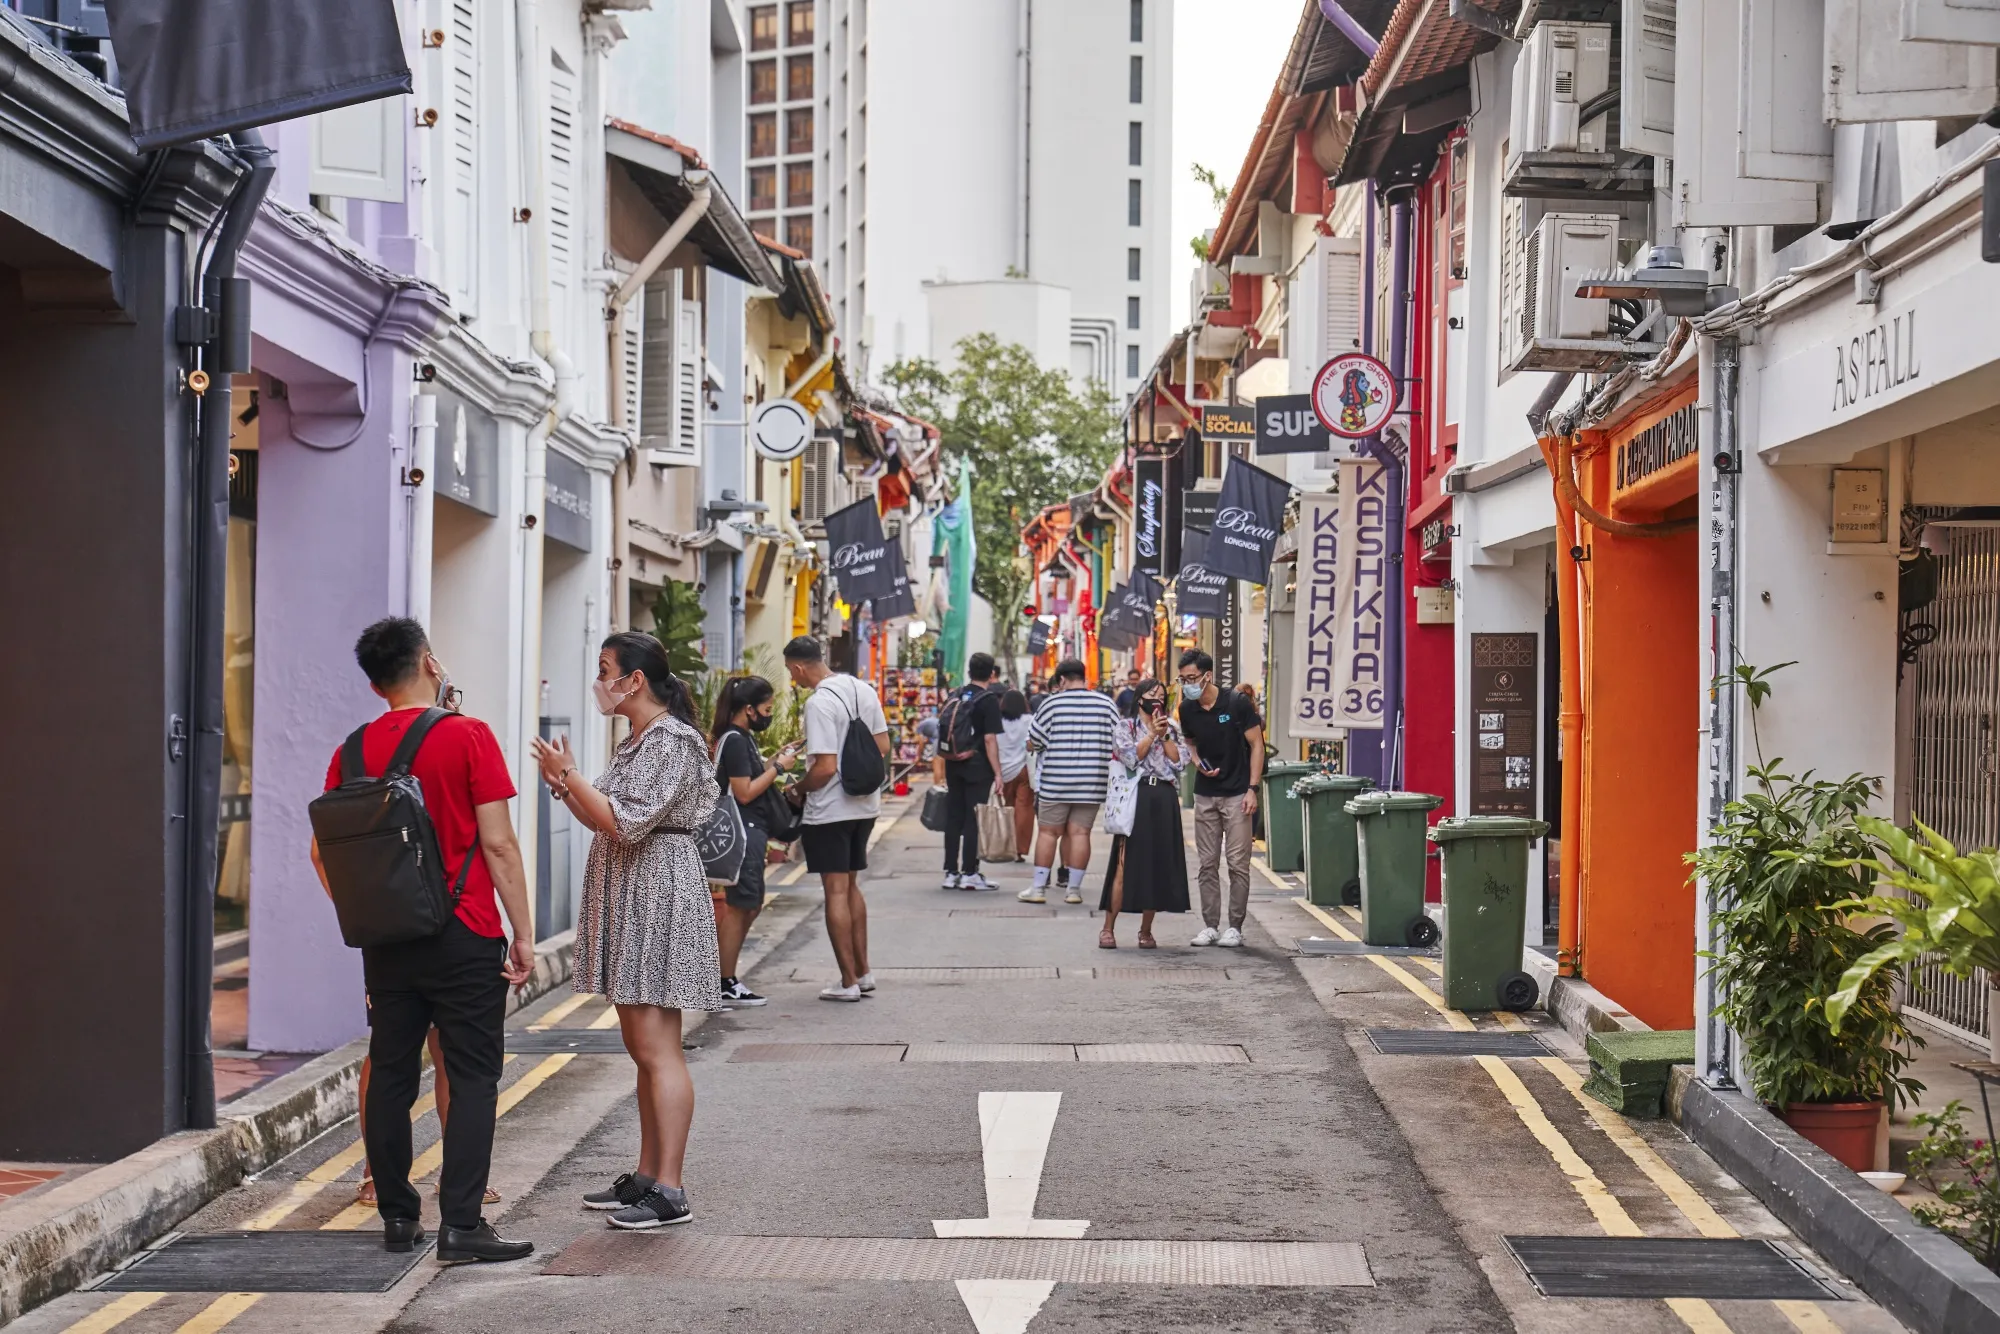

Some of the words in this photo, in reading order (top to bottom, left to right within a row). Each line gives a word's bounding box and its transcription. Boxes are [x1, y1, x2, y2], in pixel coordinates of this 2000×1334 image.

[1321, 368, 1339, 388] THE
[1339, 361, 1364, 370] GIFT
[1366, 363, 1389, 389] SHOP
[1265, 410, 1320, 437] SUP
[1667, 400, 1698, 466] PARAD
[1135, 479, 1162, 558] Simplicity
[1216, 506, 1276, 540] Beau
[834, 541, 886, 568] Beau
[1224, 535, 1260, 551] LONGNOSE
[1181, 563, 1228, 586] Beau
[1352, 465, 1386, 682] KASHKHA
[1306, 507, 1339, 692] KASHKHA
[1221, 653, 1233, 689] NAIL
[1299, 698, 1334, 720] 36
[1343, 689, 1384, 714] 36
